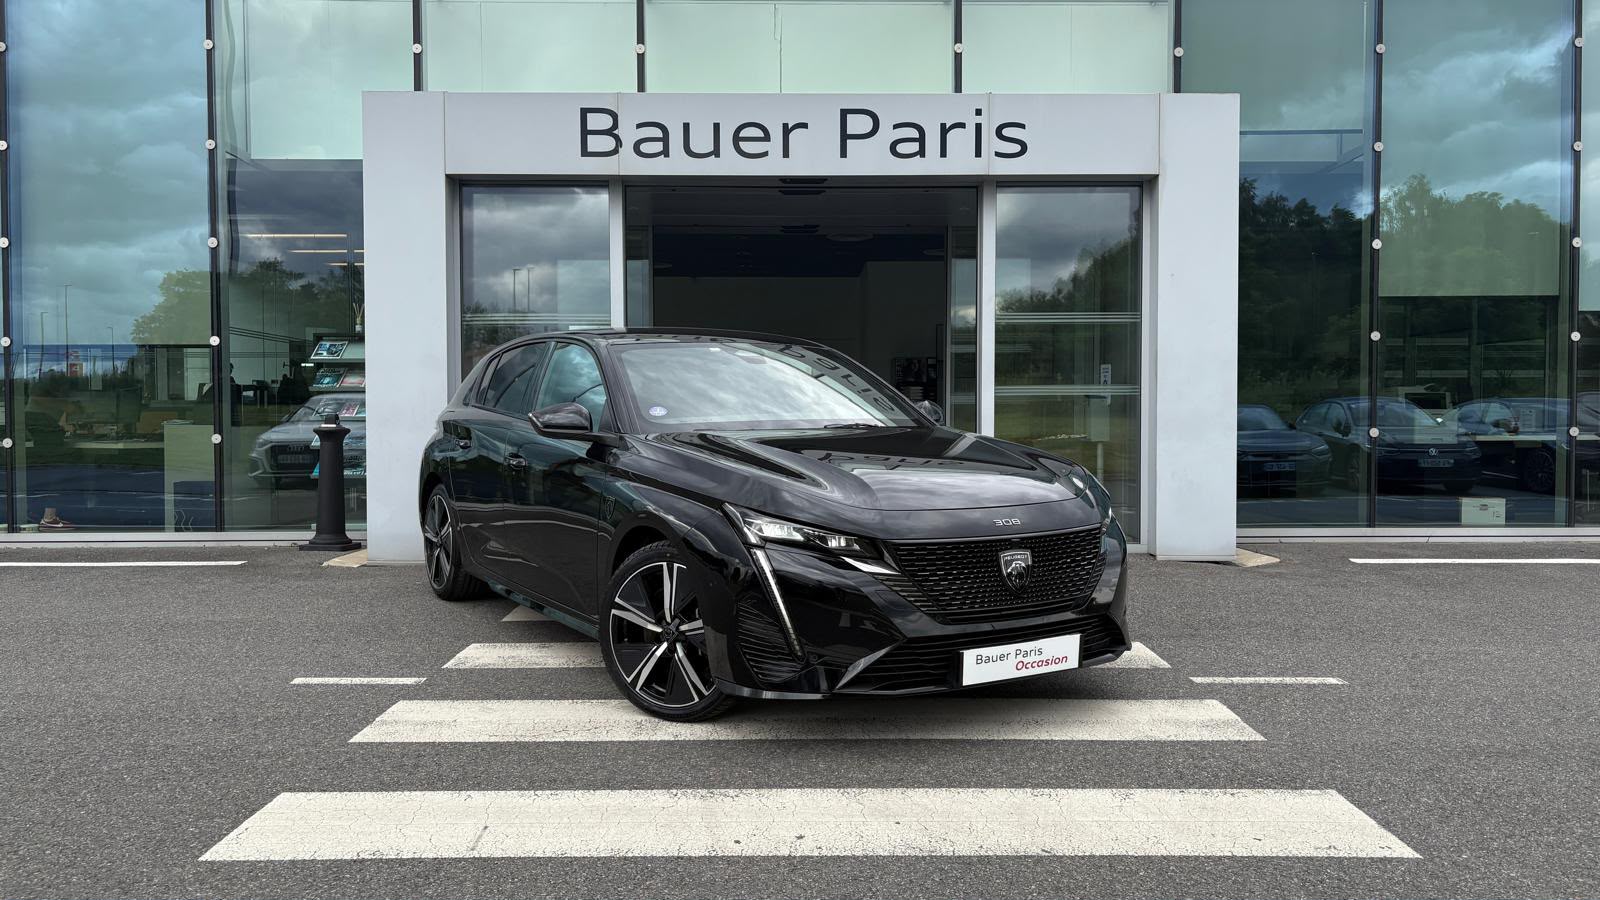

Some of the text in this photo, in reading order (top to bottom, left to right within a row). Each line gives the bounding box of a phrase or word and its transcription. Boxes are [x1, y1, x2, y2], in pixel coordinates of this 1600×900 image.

[579, 106, 1029, 160] Bauer Paris
[993, 518, 1021, 526] 308
[975, 646, 1043, 665] Bauer Paris
[1015, 654, 1068, 671] Occasion
